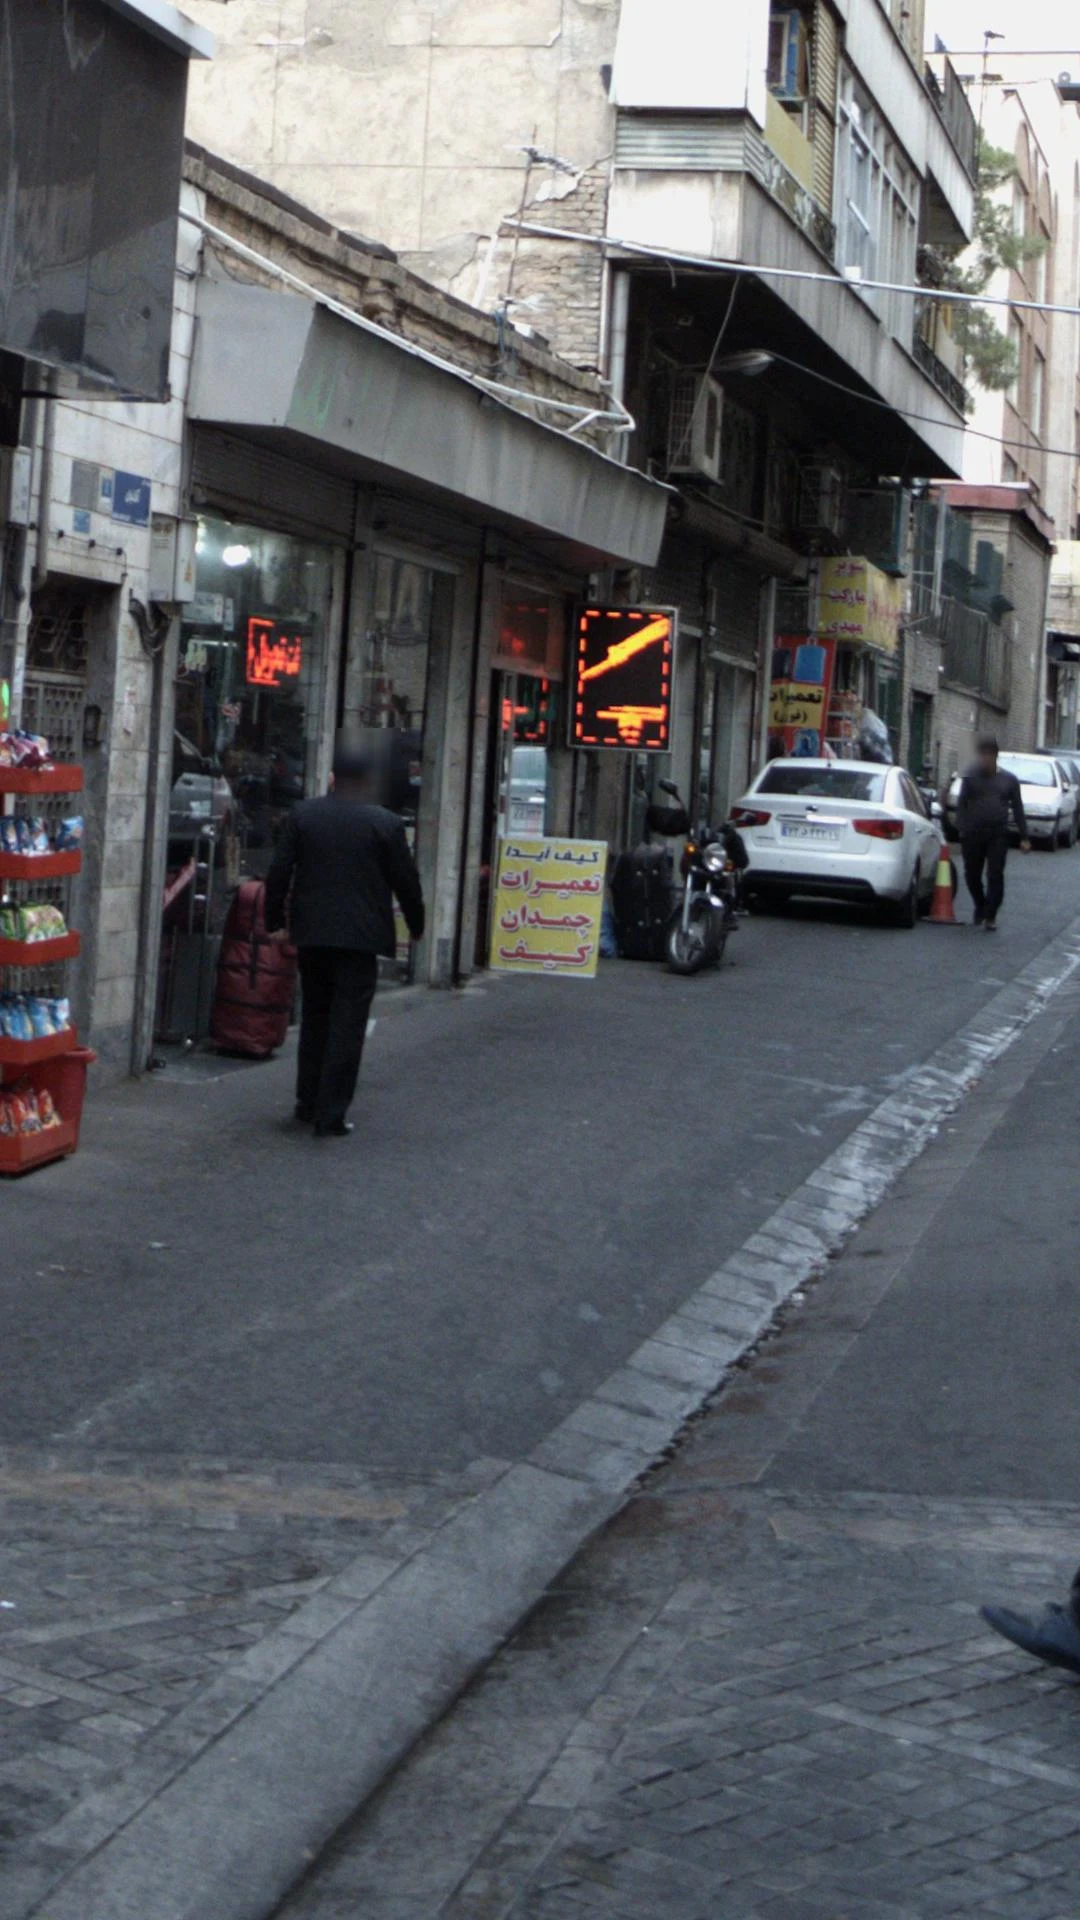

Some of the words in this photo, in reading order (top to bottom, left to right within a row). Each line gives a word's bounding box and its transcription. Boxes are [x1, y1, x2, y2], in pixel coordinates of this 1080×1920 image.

[554, 850, 599, 864] کیف
[501, 869, 602, 898] تعمیرات
[501, 904, 593, 938] چمدان
[501, 938, 592, 968] کیف
